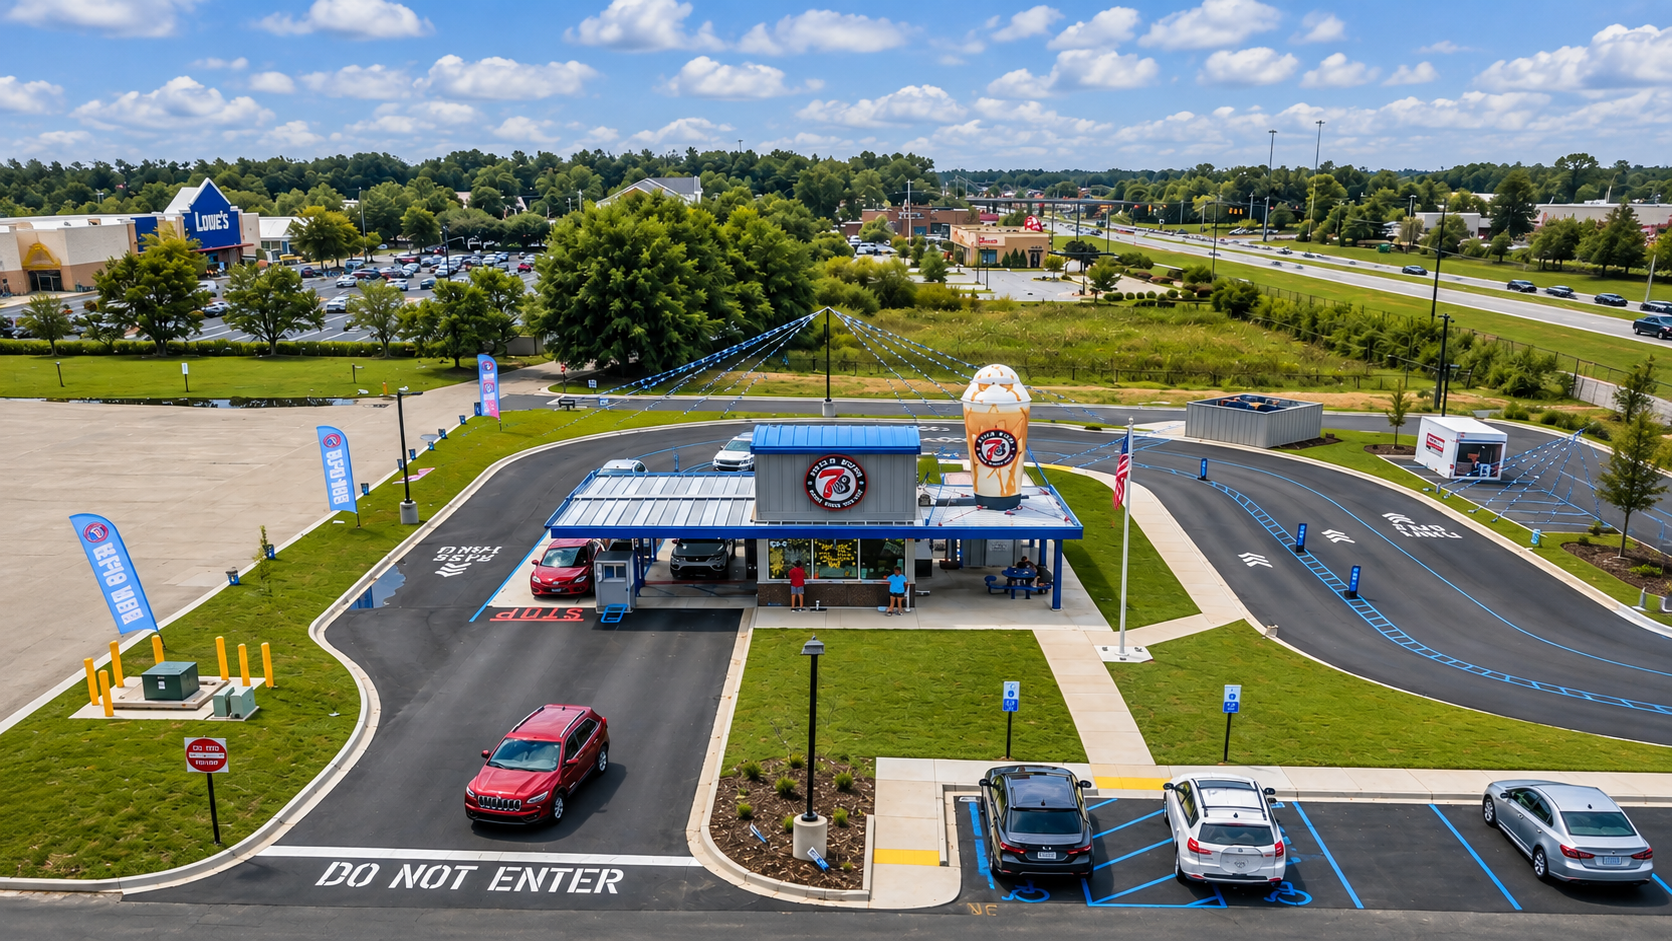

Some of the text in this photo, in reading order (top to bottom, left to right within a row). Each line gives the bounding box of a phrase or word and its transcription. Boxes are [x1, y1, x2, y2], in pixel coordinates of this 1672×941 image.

[194, 210, 230, 232] LOWE'S
[314, 861, 625, 894] DO NOT ENTER
